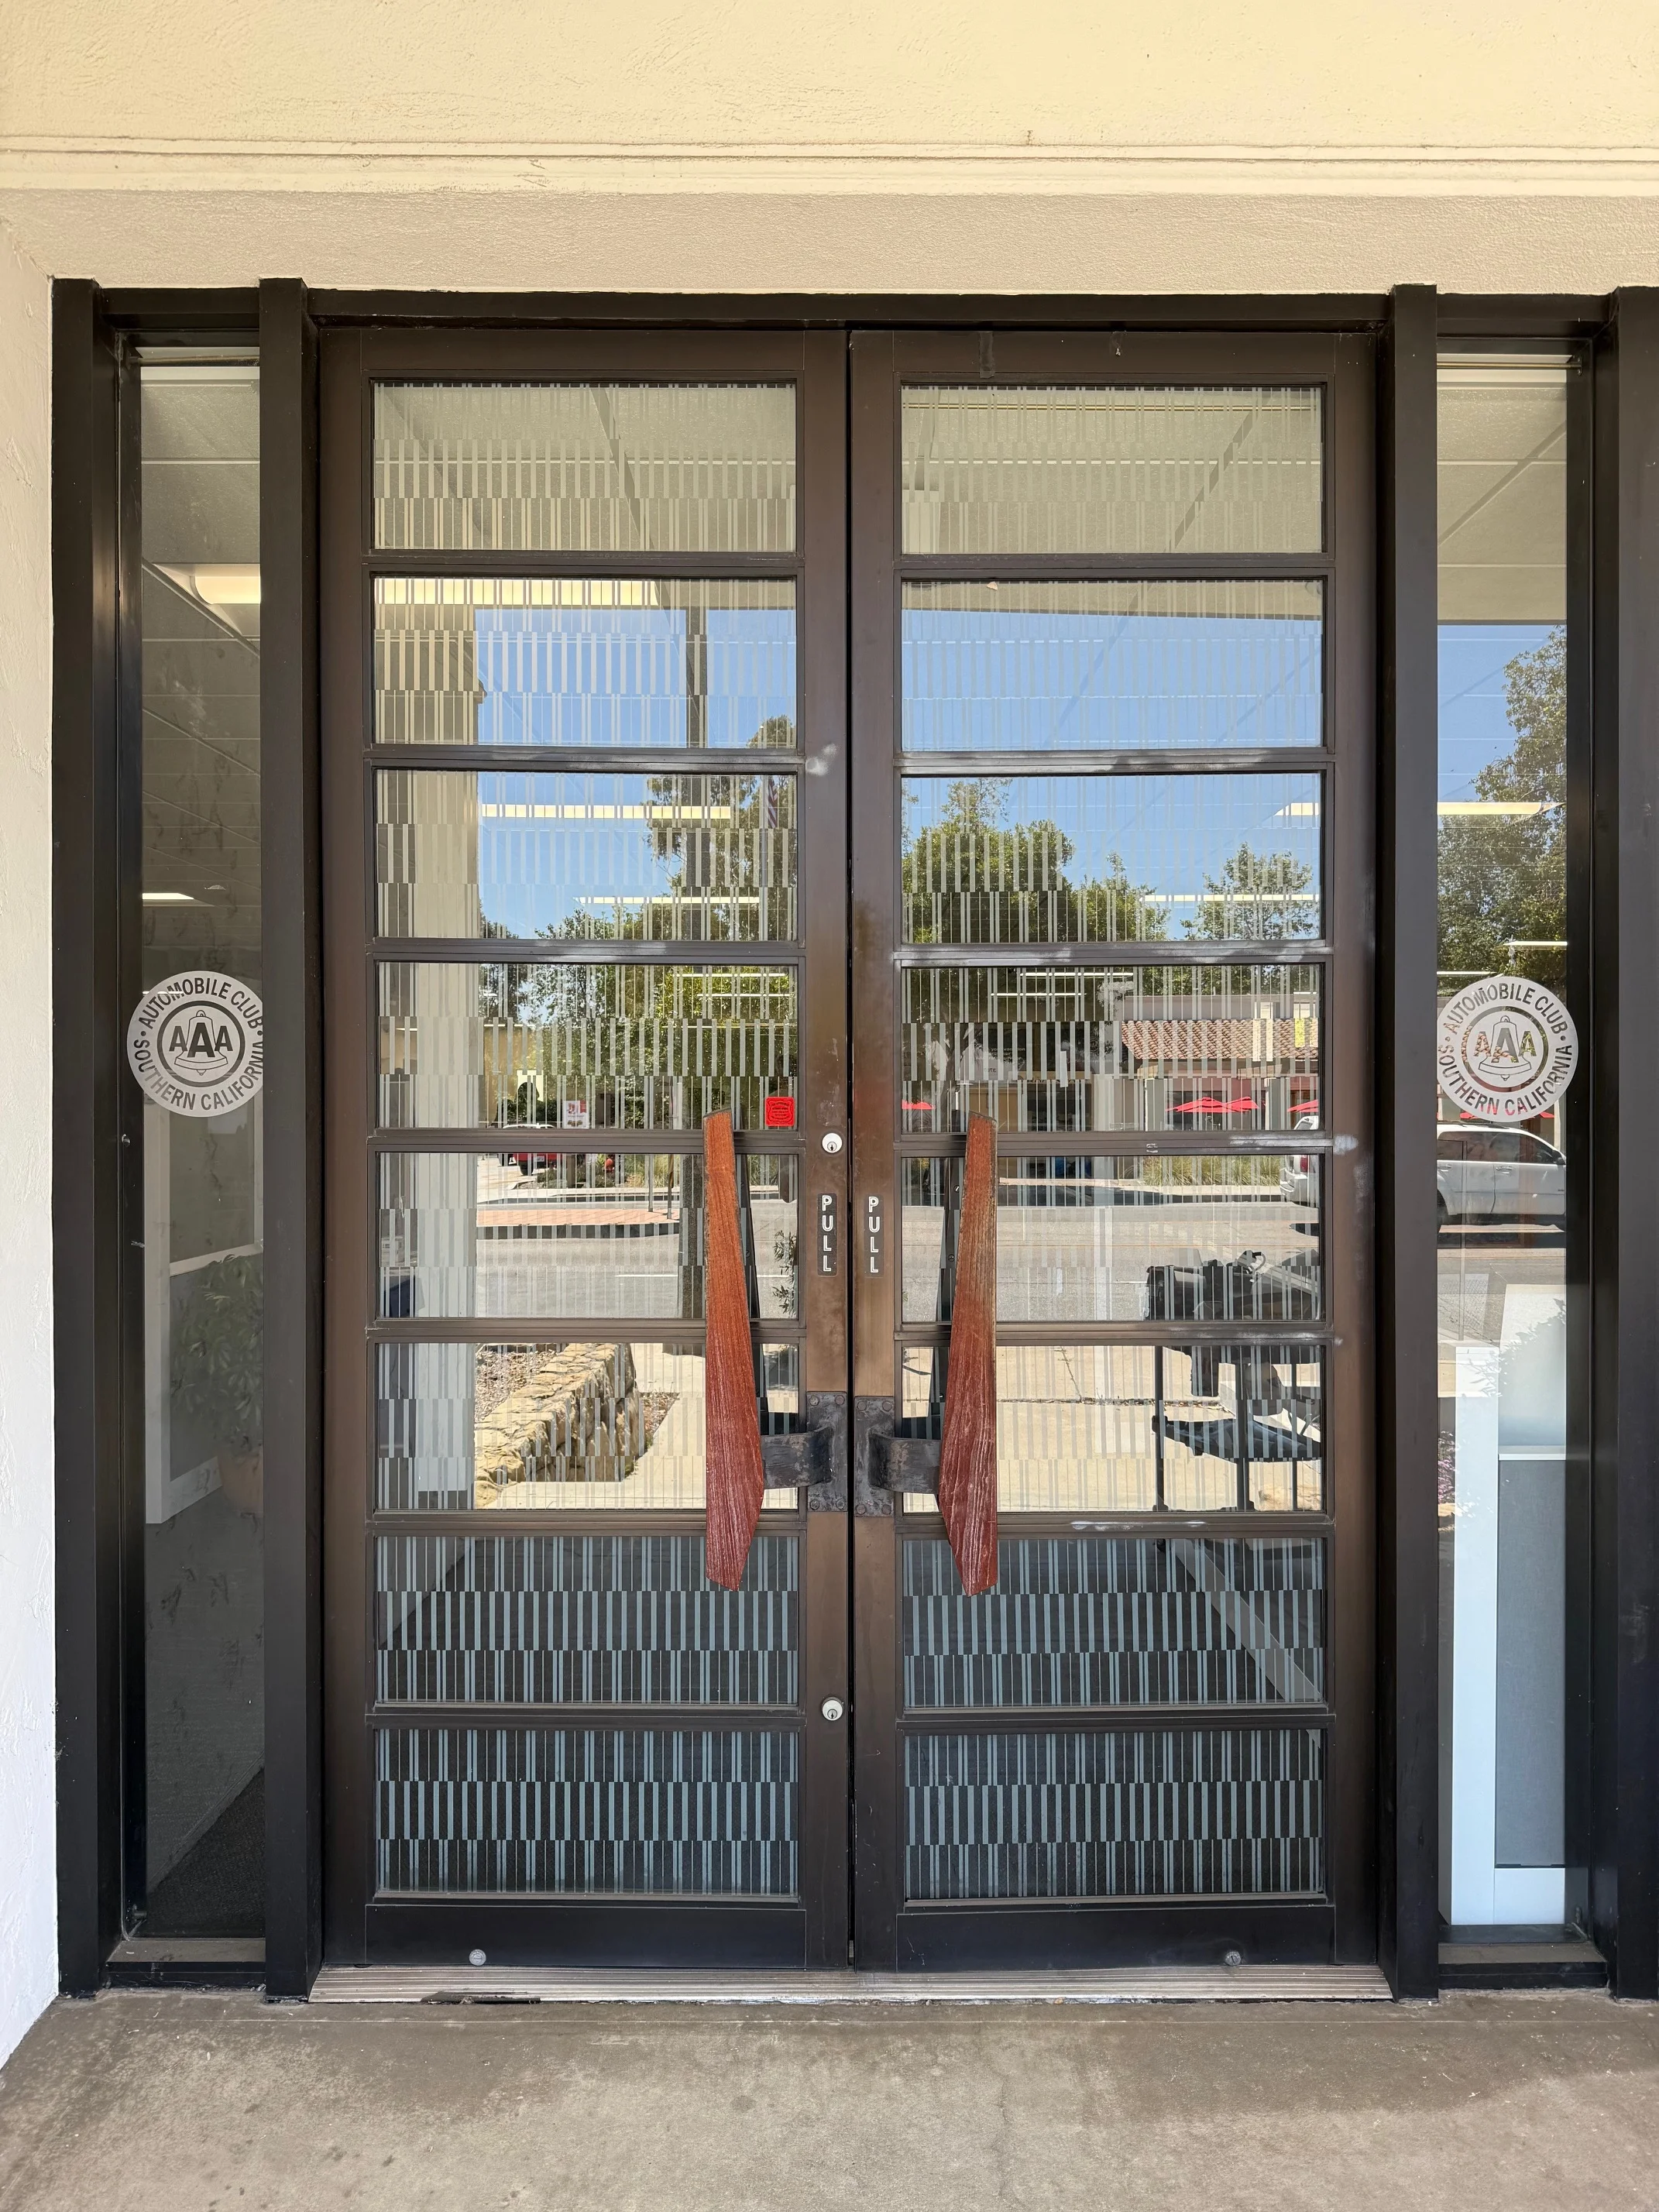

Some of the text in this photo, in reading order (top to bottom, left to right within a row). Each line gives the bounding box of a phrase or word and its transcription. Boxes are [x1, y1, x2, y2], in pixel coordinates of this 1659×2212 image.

[138, 977, 263, 1029] AUTOMOBILE CLUB
[1443, 983, 1568, 1035] AUTOMOBILE CLUB
[169, 1022, 233, 1058] AAA
[1473, 1027, 1537, 1063] AAA
[133, 1039, 196, 1111] SOUTHERN
[1438, 1044, 1572, 1115] SOUTHERN CALIFORNIA
[822, 1194, 833, 1272] PULL
[868, 1196, 881, 1273] PULL
